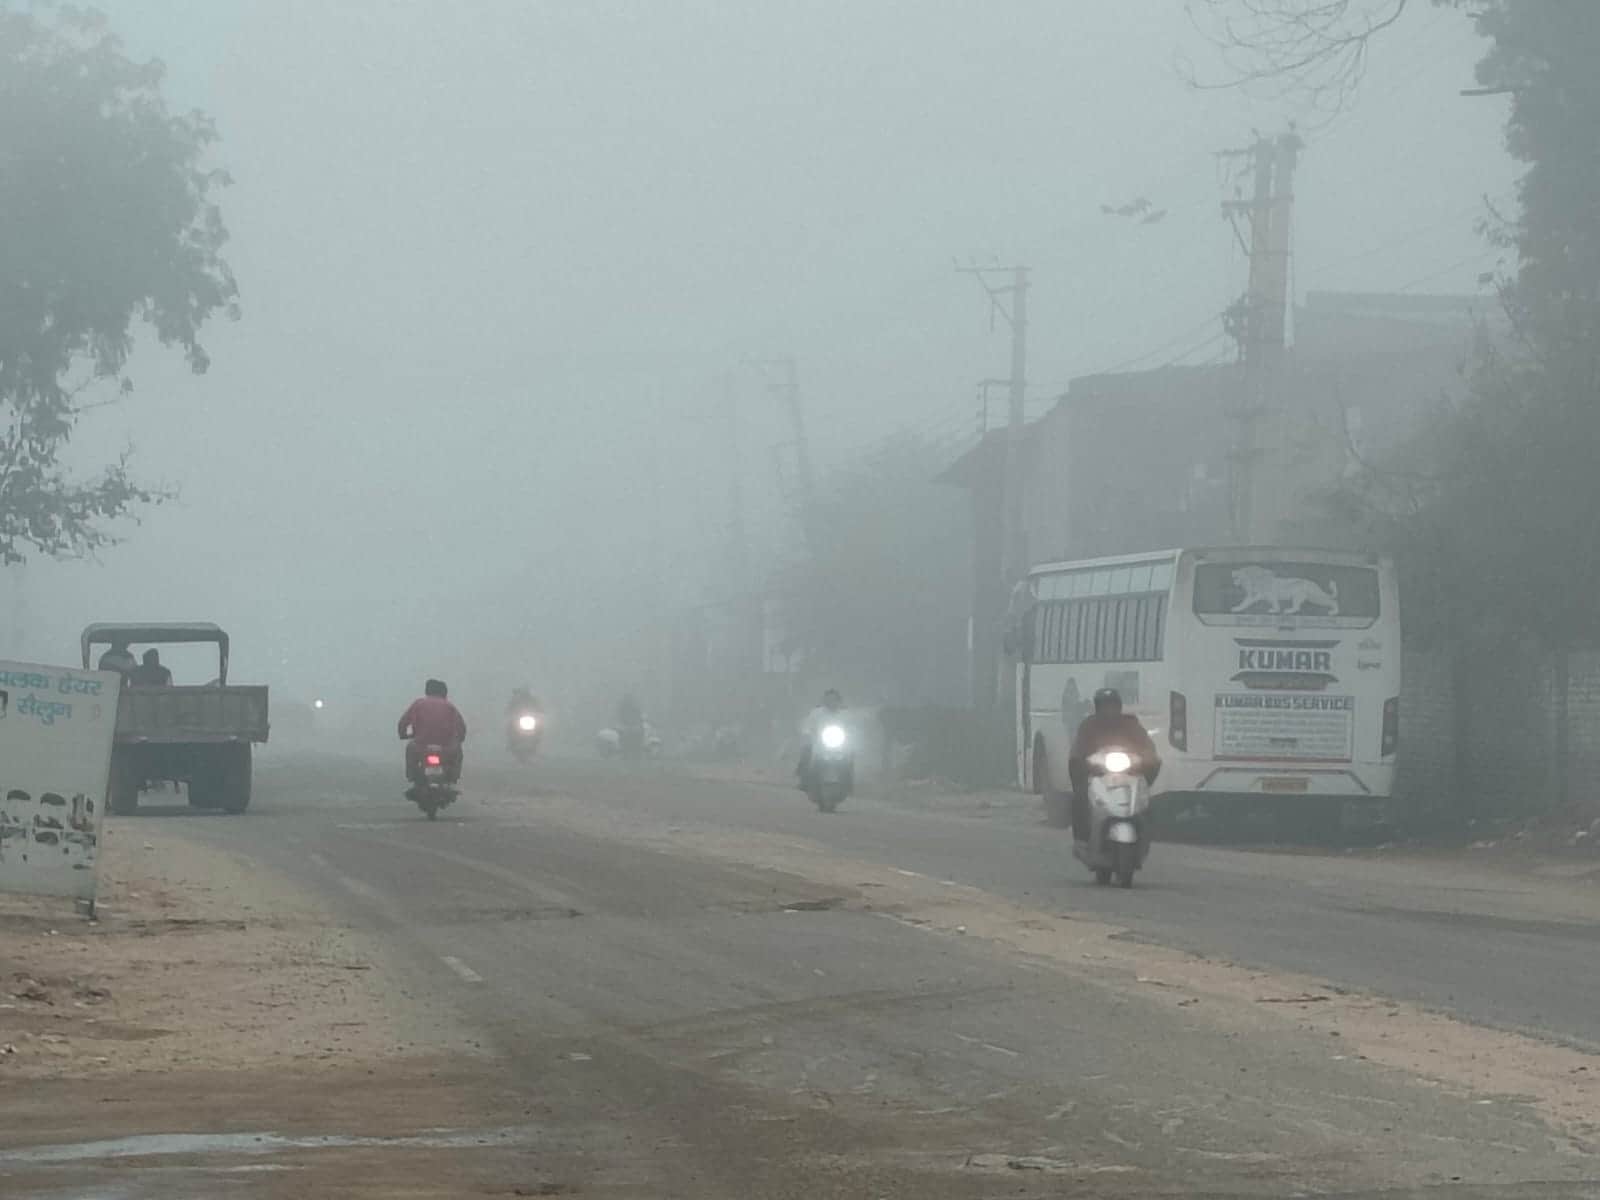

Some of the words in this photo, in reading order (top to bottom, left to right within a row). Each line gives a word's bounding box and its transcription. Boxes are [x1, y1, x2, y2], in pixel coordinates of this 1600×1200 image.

[1239, 649, 1331, 670] KUMAR
[1215, 695, 1262, 708] KUMAR
[1264, 696, 1291, 709] BUS
[1293, 696, 1353, 711] SERVICE
